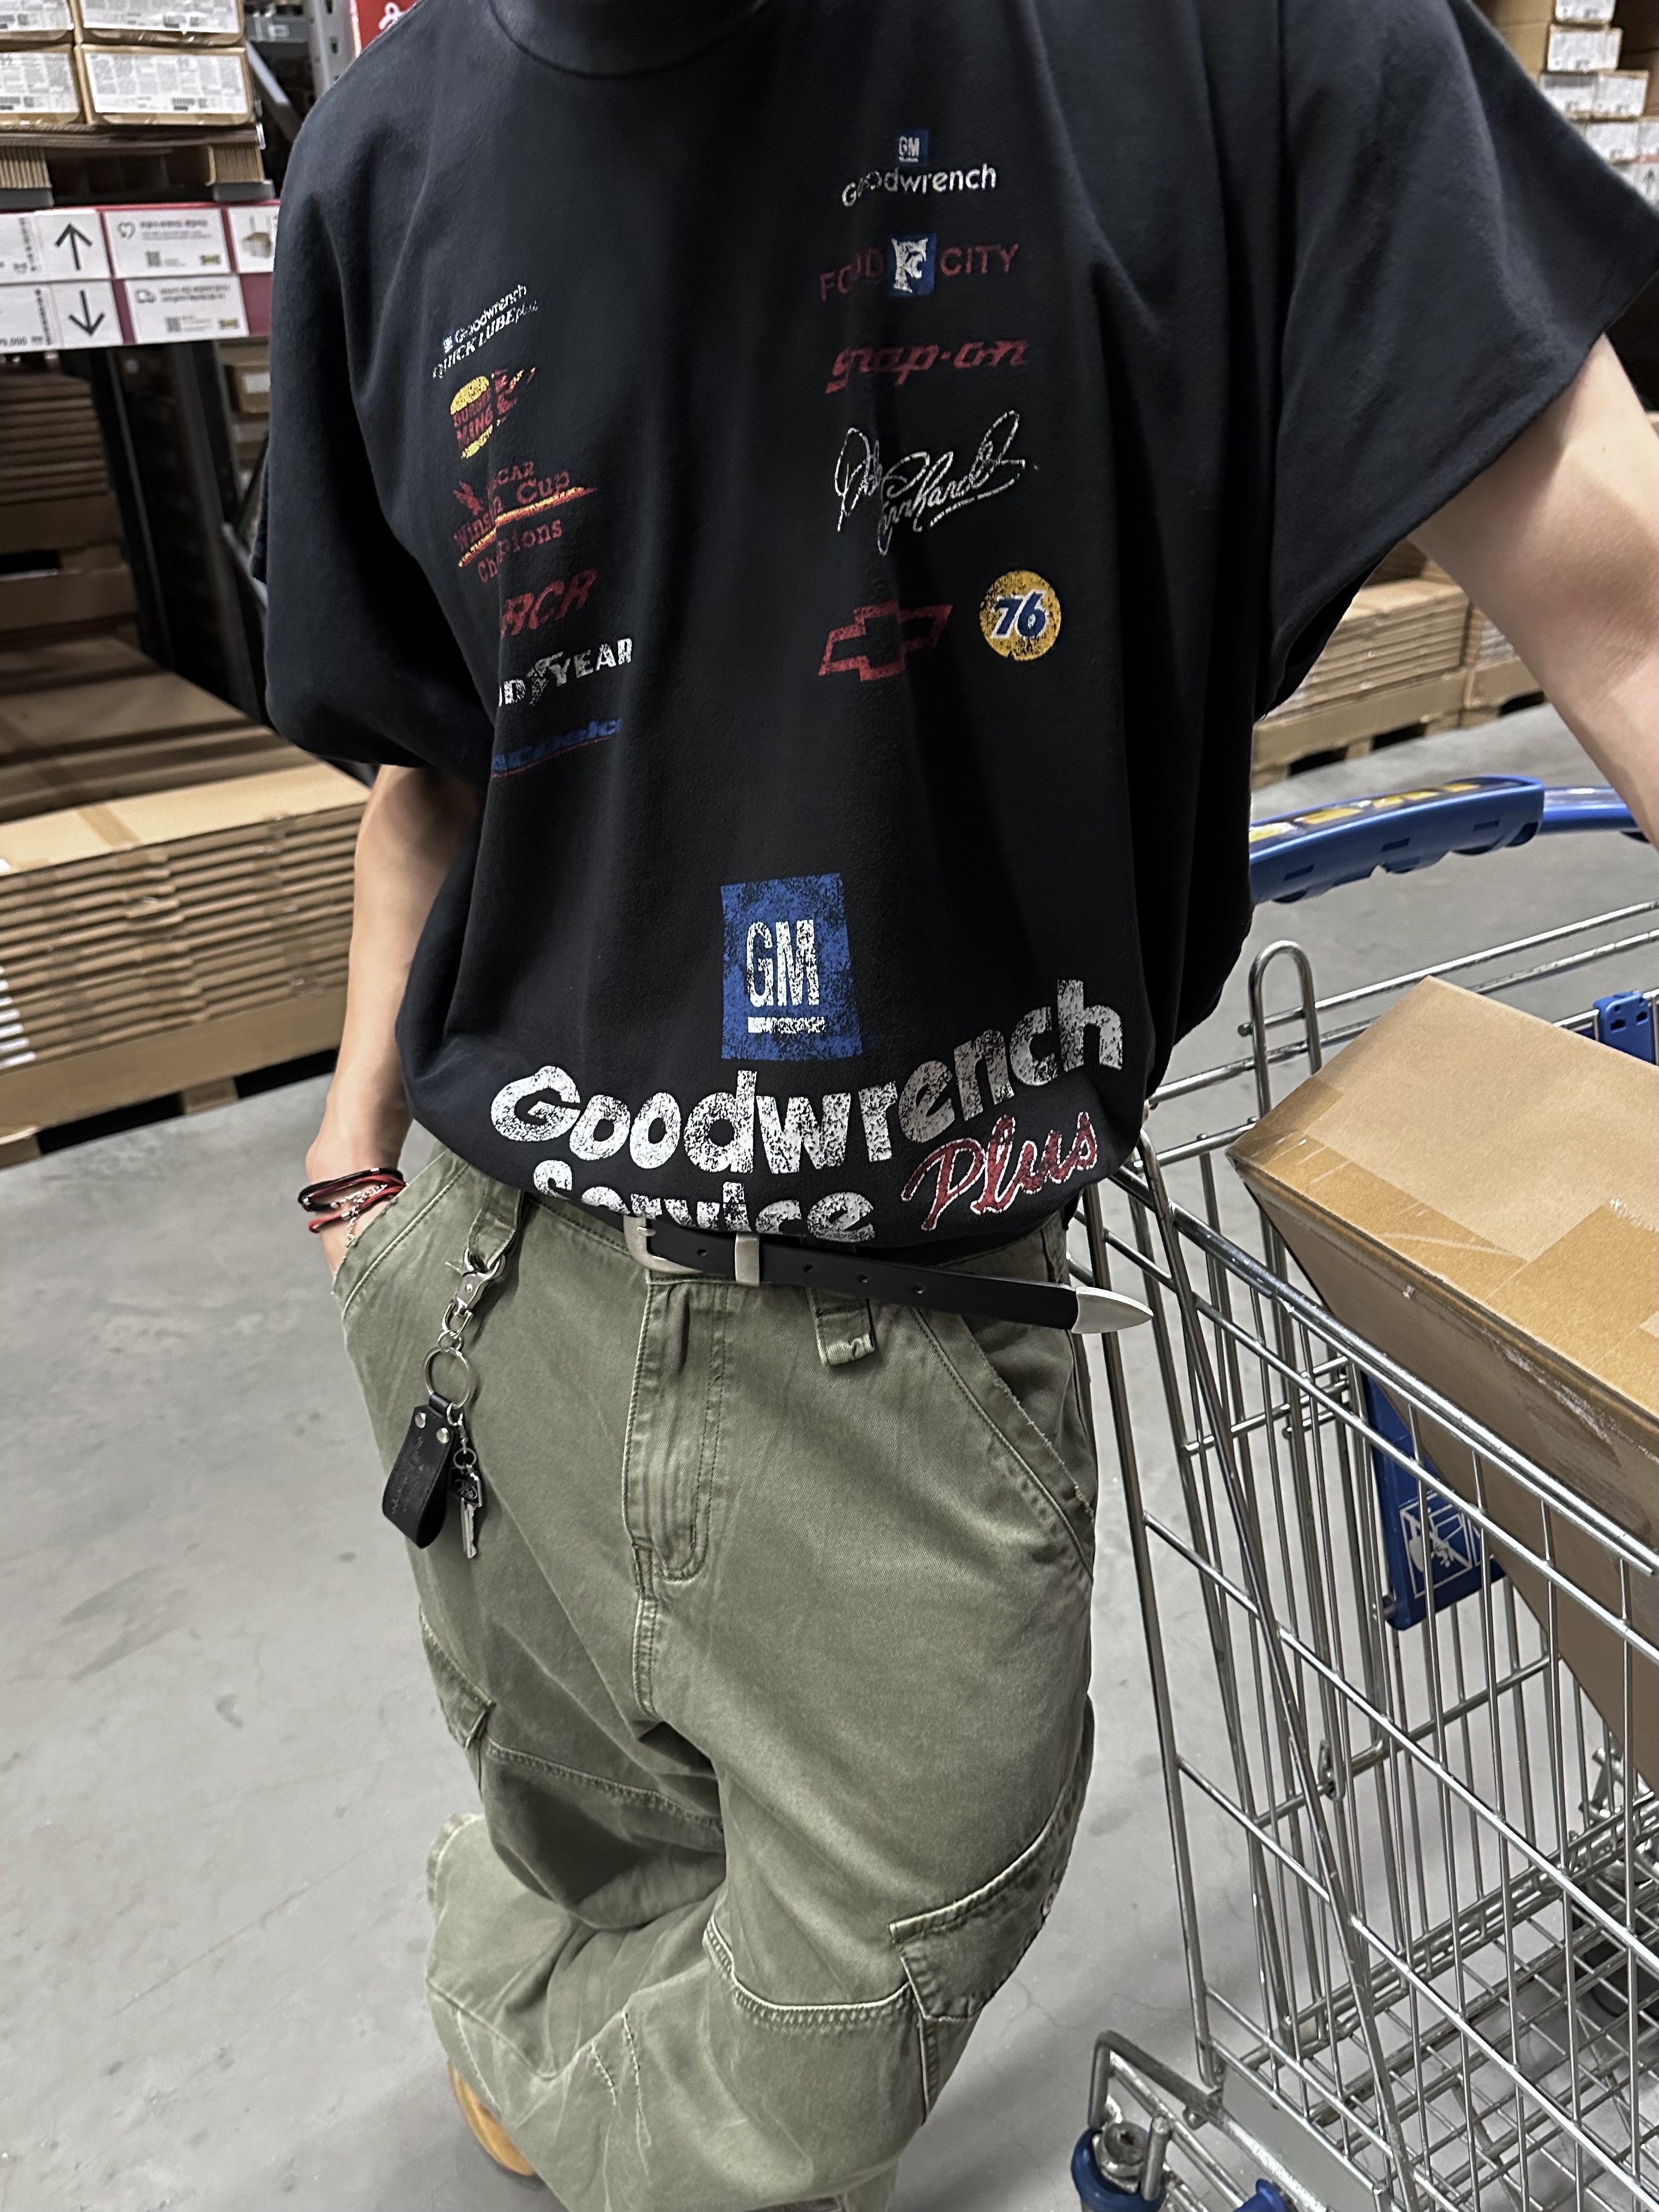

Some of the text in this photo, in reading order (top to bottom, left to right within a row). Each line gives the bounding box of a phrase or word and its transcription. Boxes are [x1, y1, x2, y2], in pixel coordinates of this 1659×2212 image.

[899, 136, 920, 157] GM
[940, 242, 1019, 276] CITY
[990, 590, 1049, 639] 76
[746, 919, 820, 1008] GM
[490, 979, 1125, 1176] Goodwrench
[902, 1111, 1099, 1232] Plus
